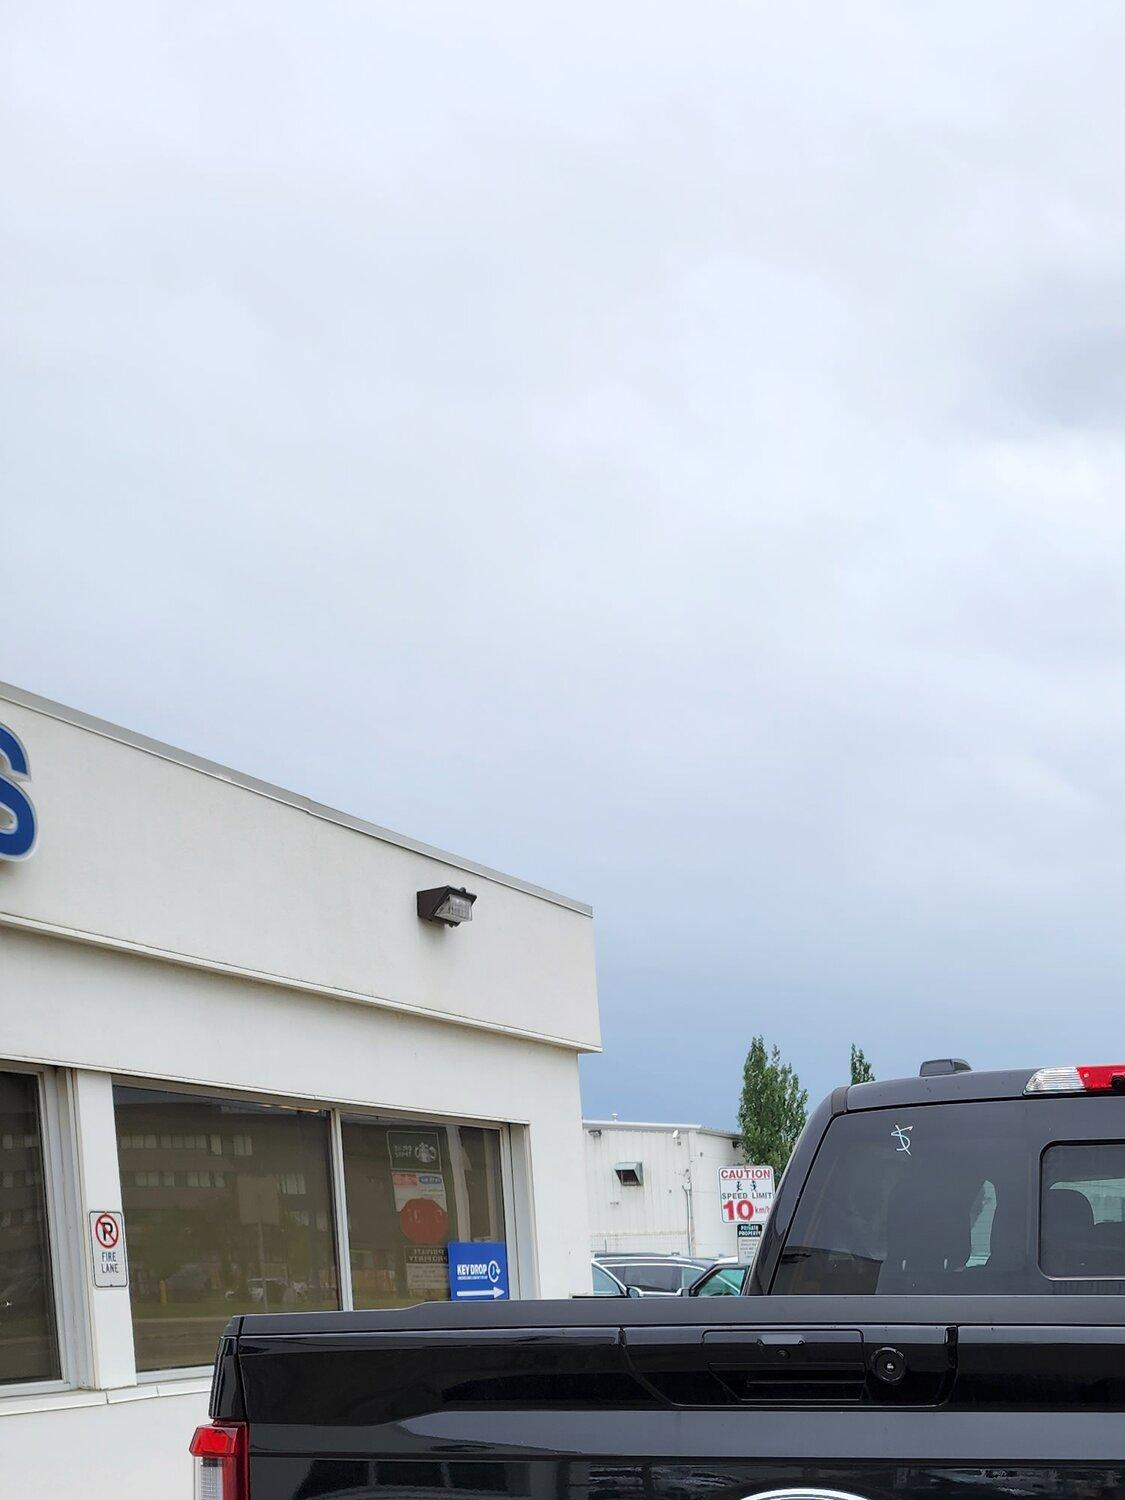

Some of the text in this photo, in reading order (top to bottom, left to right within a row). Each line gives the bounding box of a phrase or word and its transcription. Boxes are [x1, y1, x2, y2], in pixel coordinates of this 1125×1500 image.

[721, 1169, 771, 1179] CAUTION
[722, 1192, 748, 1200] SPEED
[723, 1199, 754, 1221] 10
[101, 1251, 117, 1262] FIRE
[101, 1264, 119, 1274] LANE
[456, 1264, 488, 1275] KEY DROP
